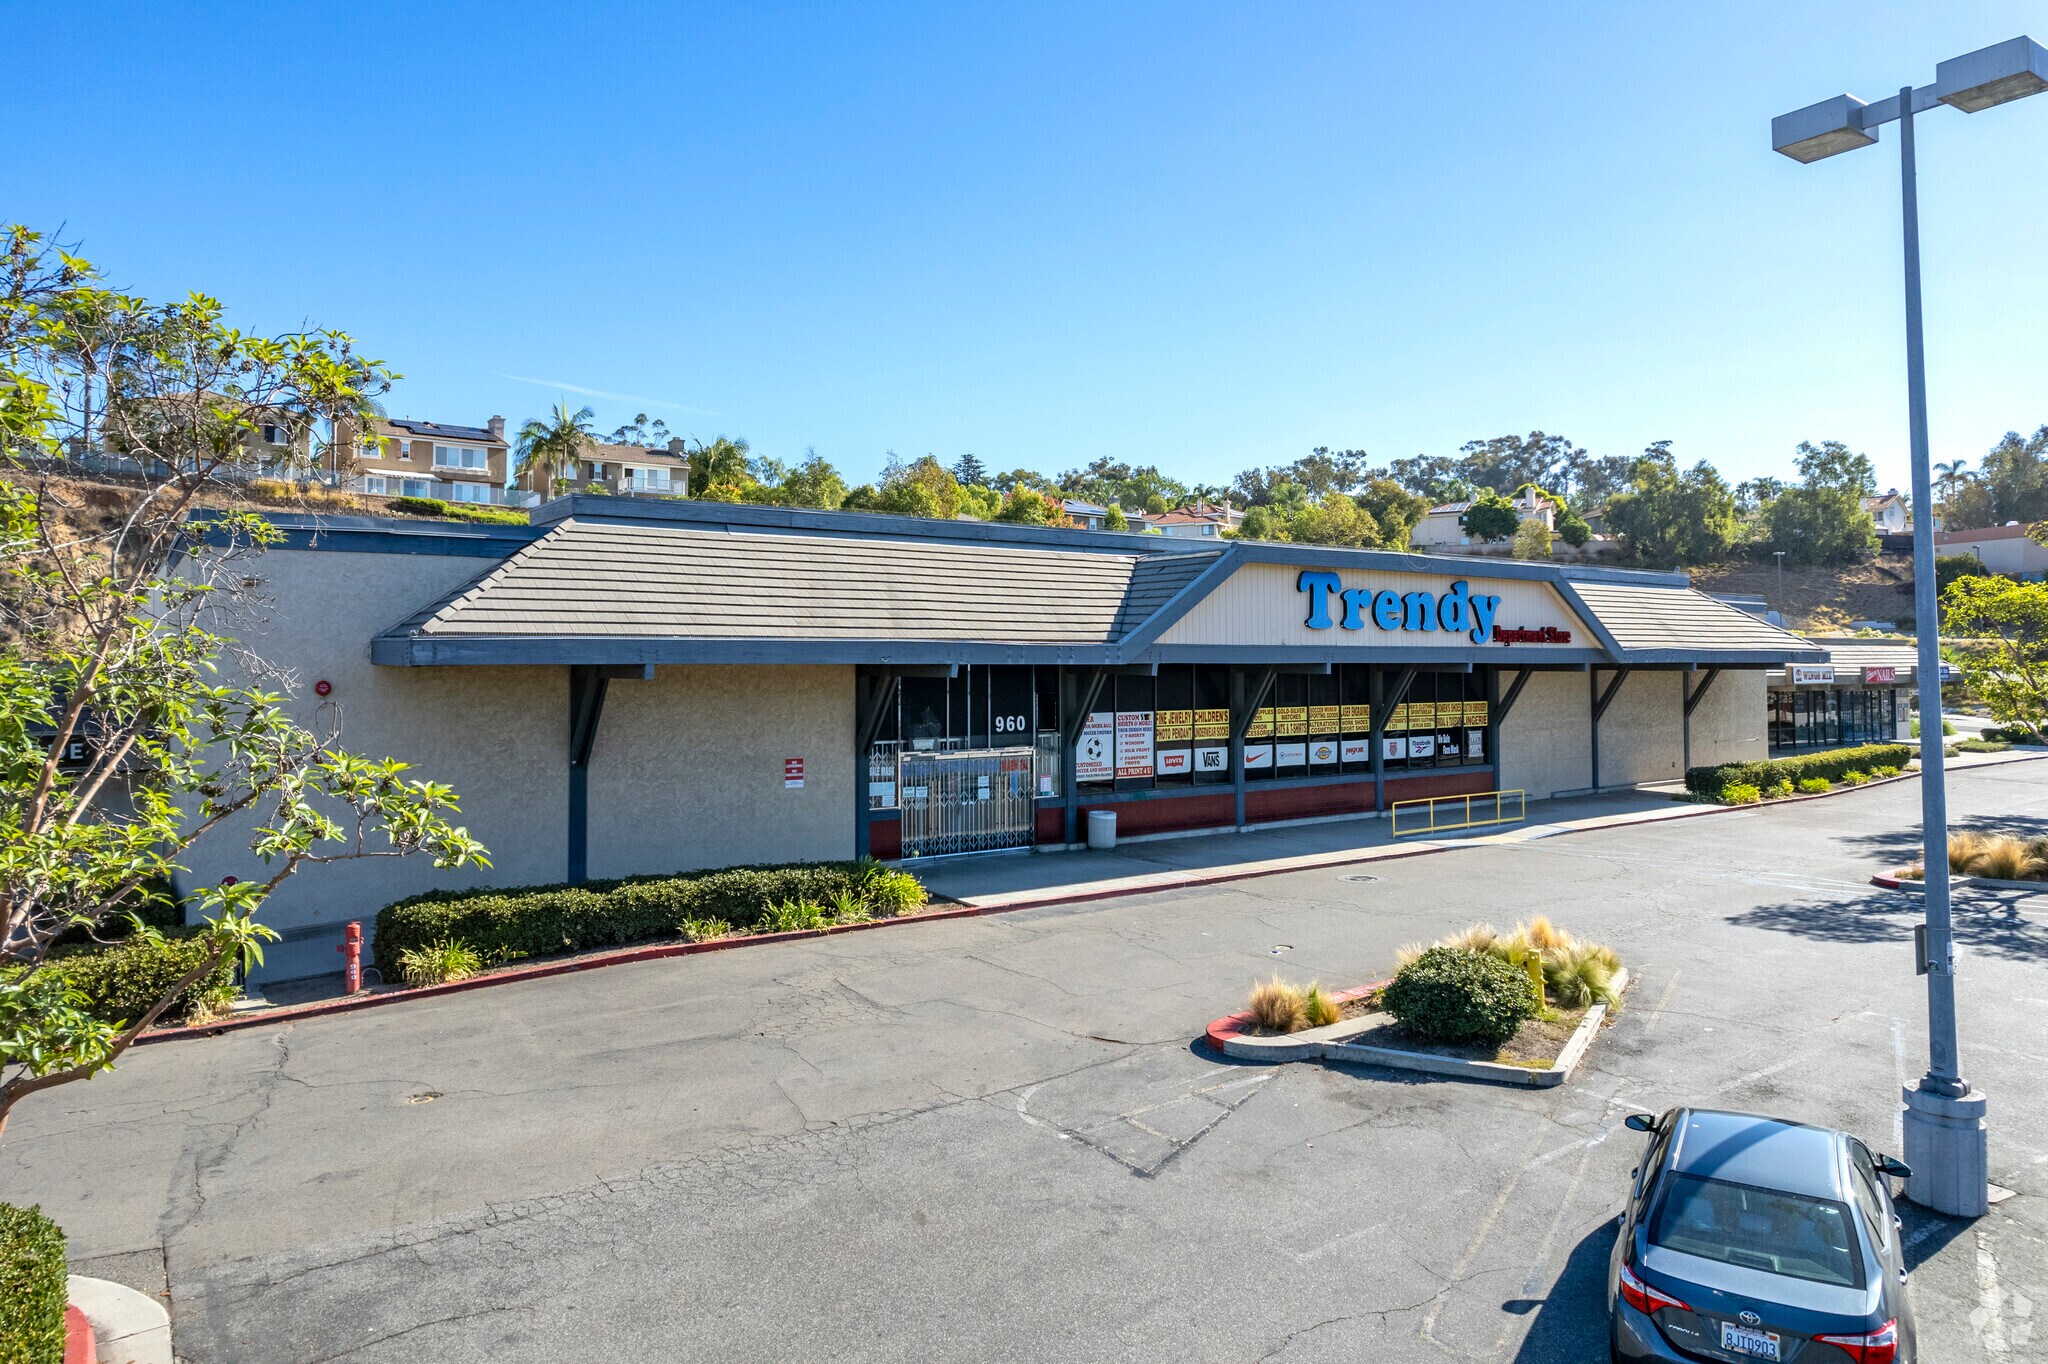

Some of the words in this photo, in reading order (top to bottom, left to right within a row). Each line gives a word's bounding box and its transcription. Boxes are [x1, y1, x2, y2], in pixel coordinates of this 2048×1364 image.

[1296, 570, 1501, 645] Trendy
[1493, 625, 1546, 646] Department
[1546, 626, 1571, 643] Store
[1877, 669, 1895, 681] NAILS
[995, 715, 1026, 732] 960
[1168, 712, 1191, 724] JEWELRY
[1194, 711, 1228, 723] CHILDREN'S
[1156, 728, 1171, 740] PHOTO
[1172, 728, 1191, 739] PENDANT
[1203, 752, 1220, 767] VANS
[1726, 1332, 1776, 1356] 8JID903
